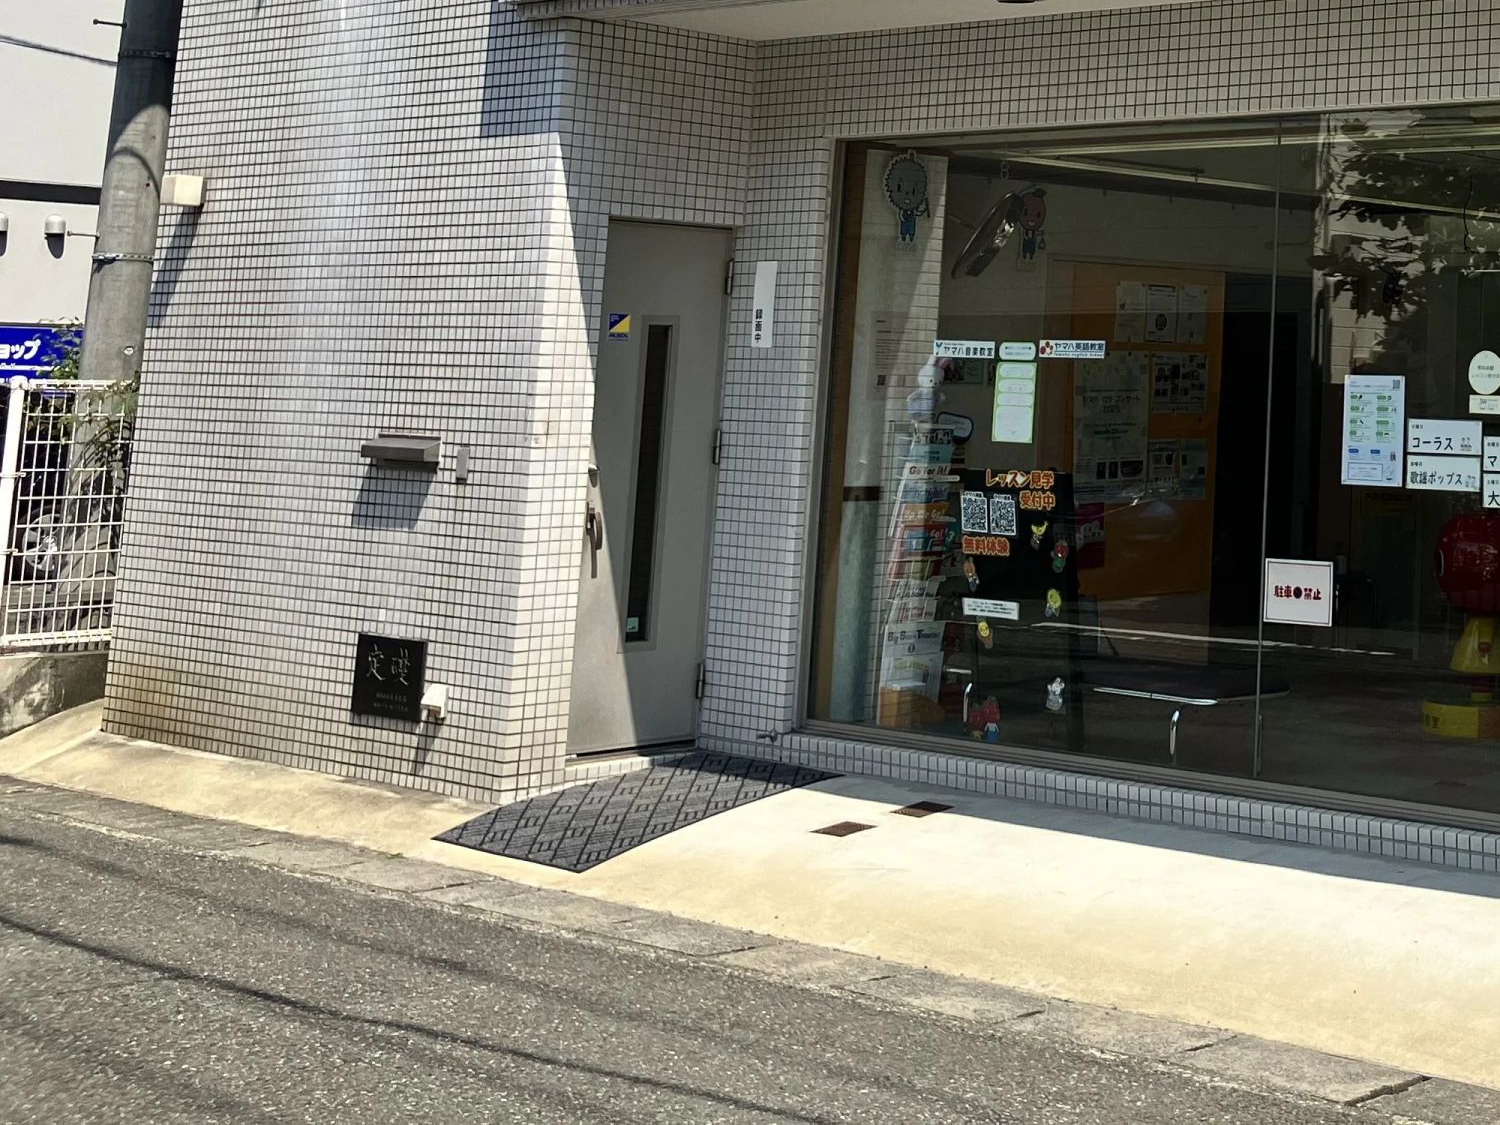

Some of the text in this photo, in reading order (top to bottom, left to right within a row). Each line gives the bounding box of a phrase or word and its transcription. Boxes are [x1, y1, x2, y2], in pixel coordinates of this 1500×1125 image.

[943, 345, 994, 357] ヤマハ音楽教室
[1054, 341, 1105, 352] ヤマハ英語教室
[1412, 436, 1454, 451] コーラス
[985, 468, 1055, 489] レッスン見学
[1019, 490, 1056, 510] 受付中
[962, 536, 1010, 556] 無料体験
[1274, 585, 1322, 600] 駐車 禁止
